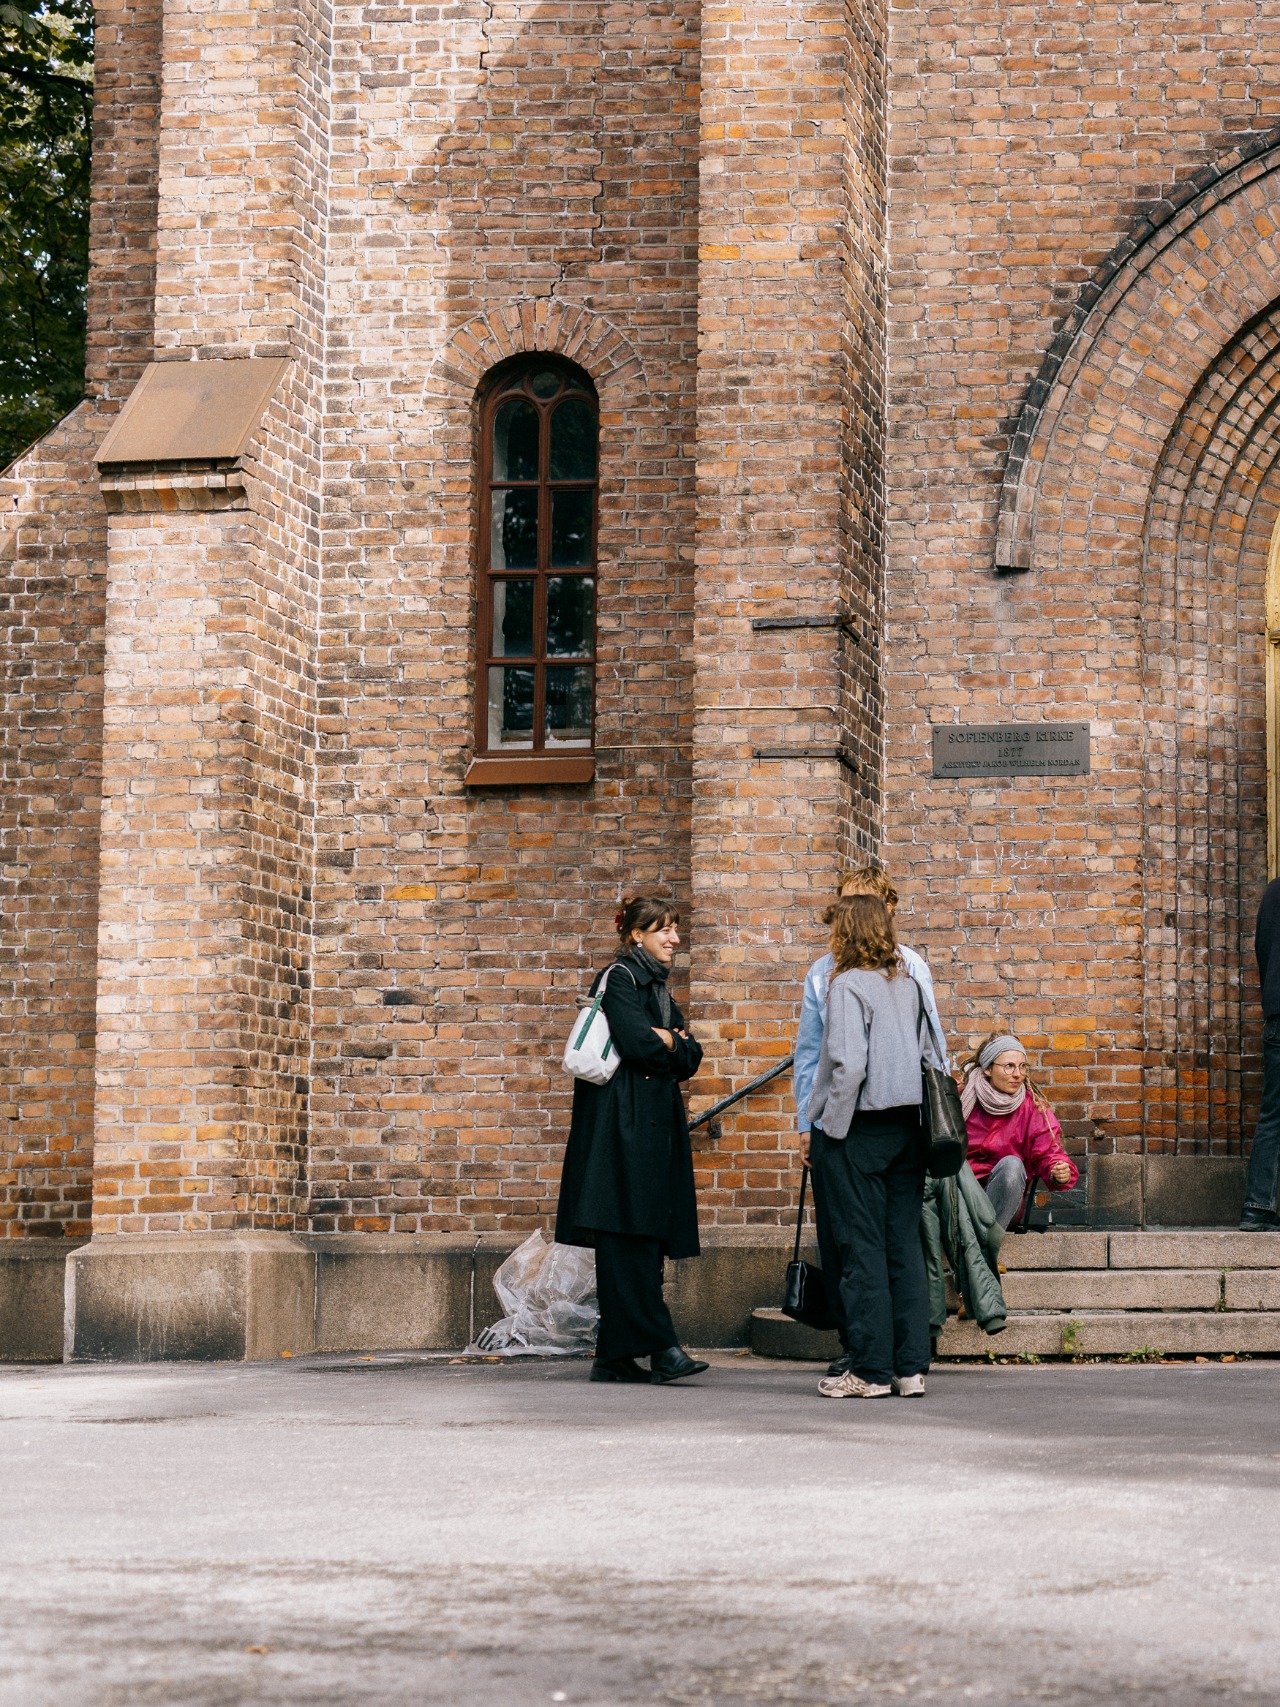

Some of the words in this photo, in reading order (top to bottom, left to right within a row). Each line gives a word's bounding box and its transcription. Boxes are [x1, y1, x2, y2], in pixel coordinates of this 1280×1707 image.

[948, 732, 1030, 743] SOFIENBERG
[1036, 731, 1074, 742] KIRKE
[998, 747, 1024, 757] 1877
[982, 760, 1008, 768] JAKOB
[1008, 759, 1046, 767] WILHELM
